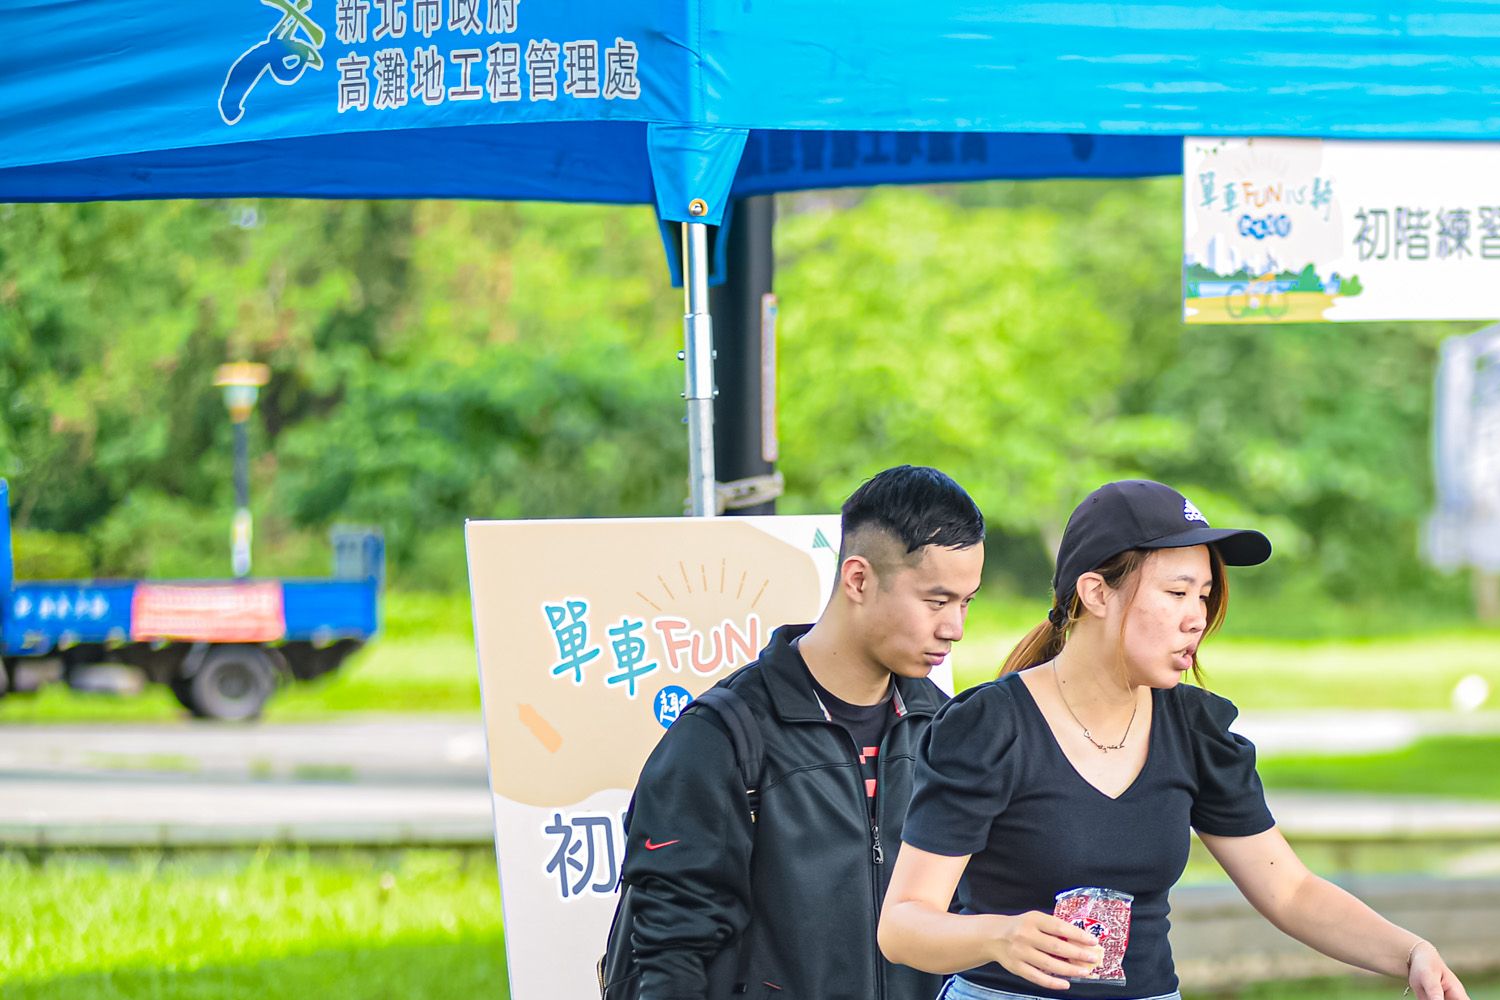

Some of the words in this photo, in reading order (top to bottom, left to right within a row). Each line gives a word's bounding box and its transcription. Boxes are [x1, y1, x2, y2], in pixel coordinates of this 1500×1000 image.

[337, 0, 519, 41] 新北市政府
[338, 38, 638, 109] 高灘地工程管理處
[545, 813, 628, 897] 初
